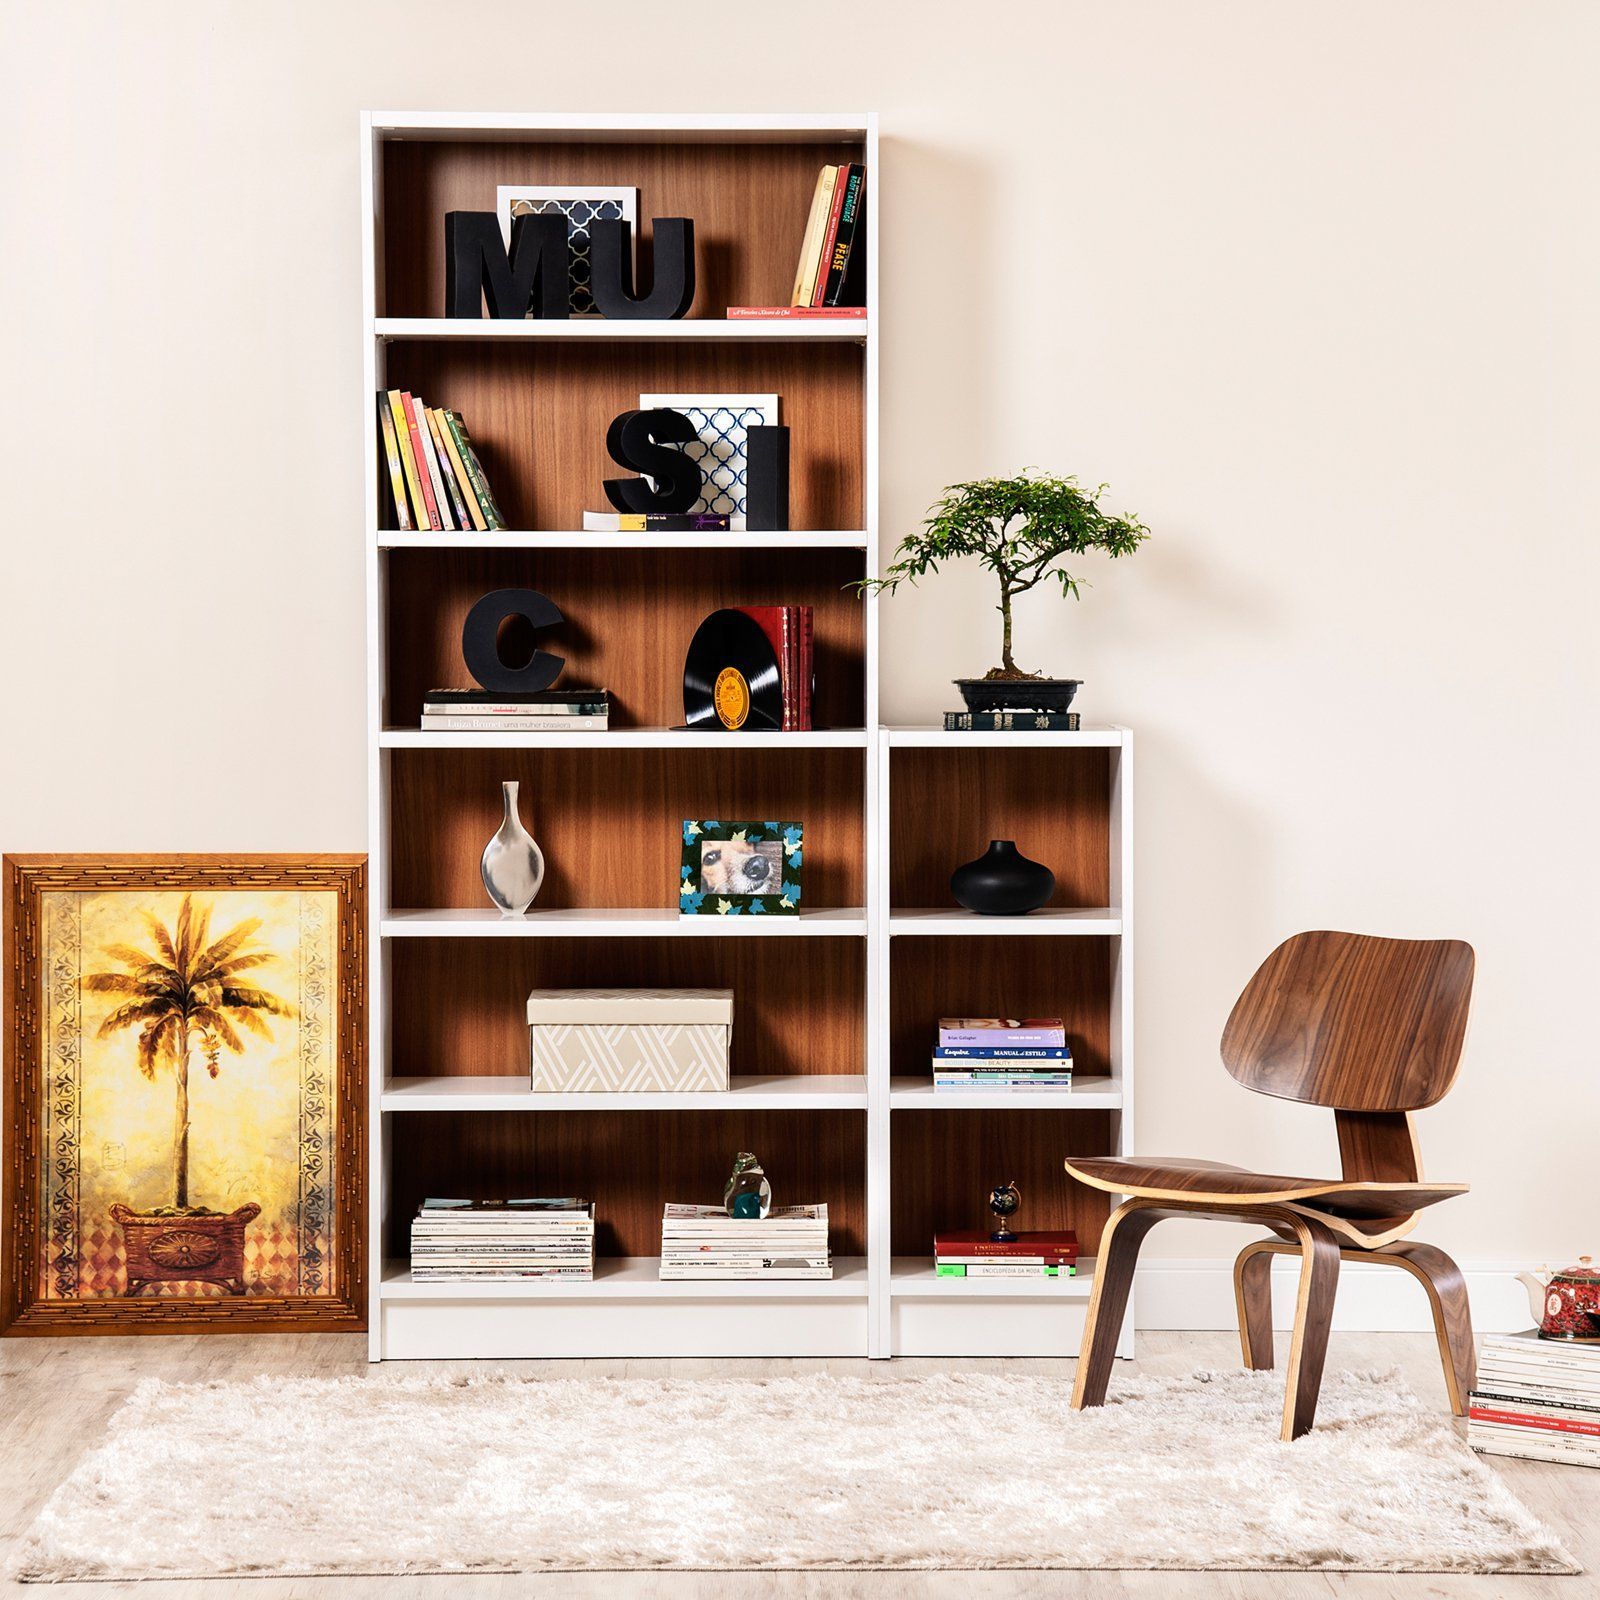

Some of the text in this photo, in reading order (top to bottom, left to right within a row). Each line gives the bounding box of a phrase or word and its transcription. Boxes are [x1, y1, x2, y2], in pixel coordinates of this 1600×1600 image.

[842, 175, 858, 223] BODY LANGUAGE
[832, 243, 847, 271] PEASE
[462, 588, 566, 693] C
[447, 718, 472, 728] Luiza
[503, 721, 518, 729] uma
[519, 719, 542, 729] mulher
[542, 719, 571, 729] brasileira
[944, 1048, 970, 1057] Esquire
